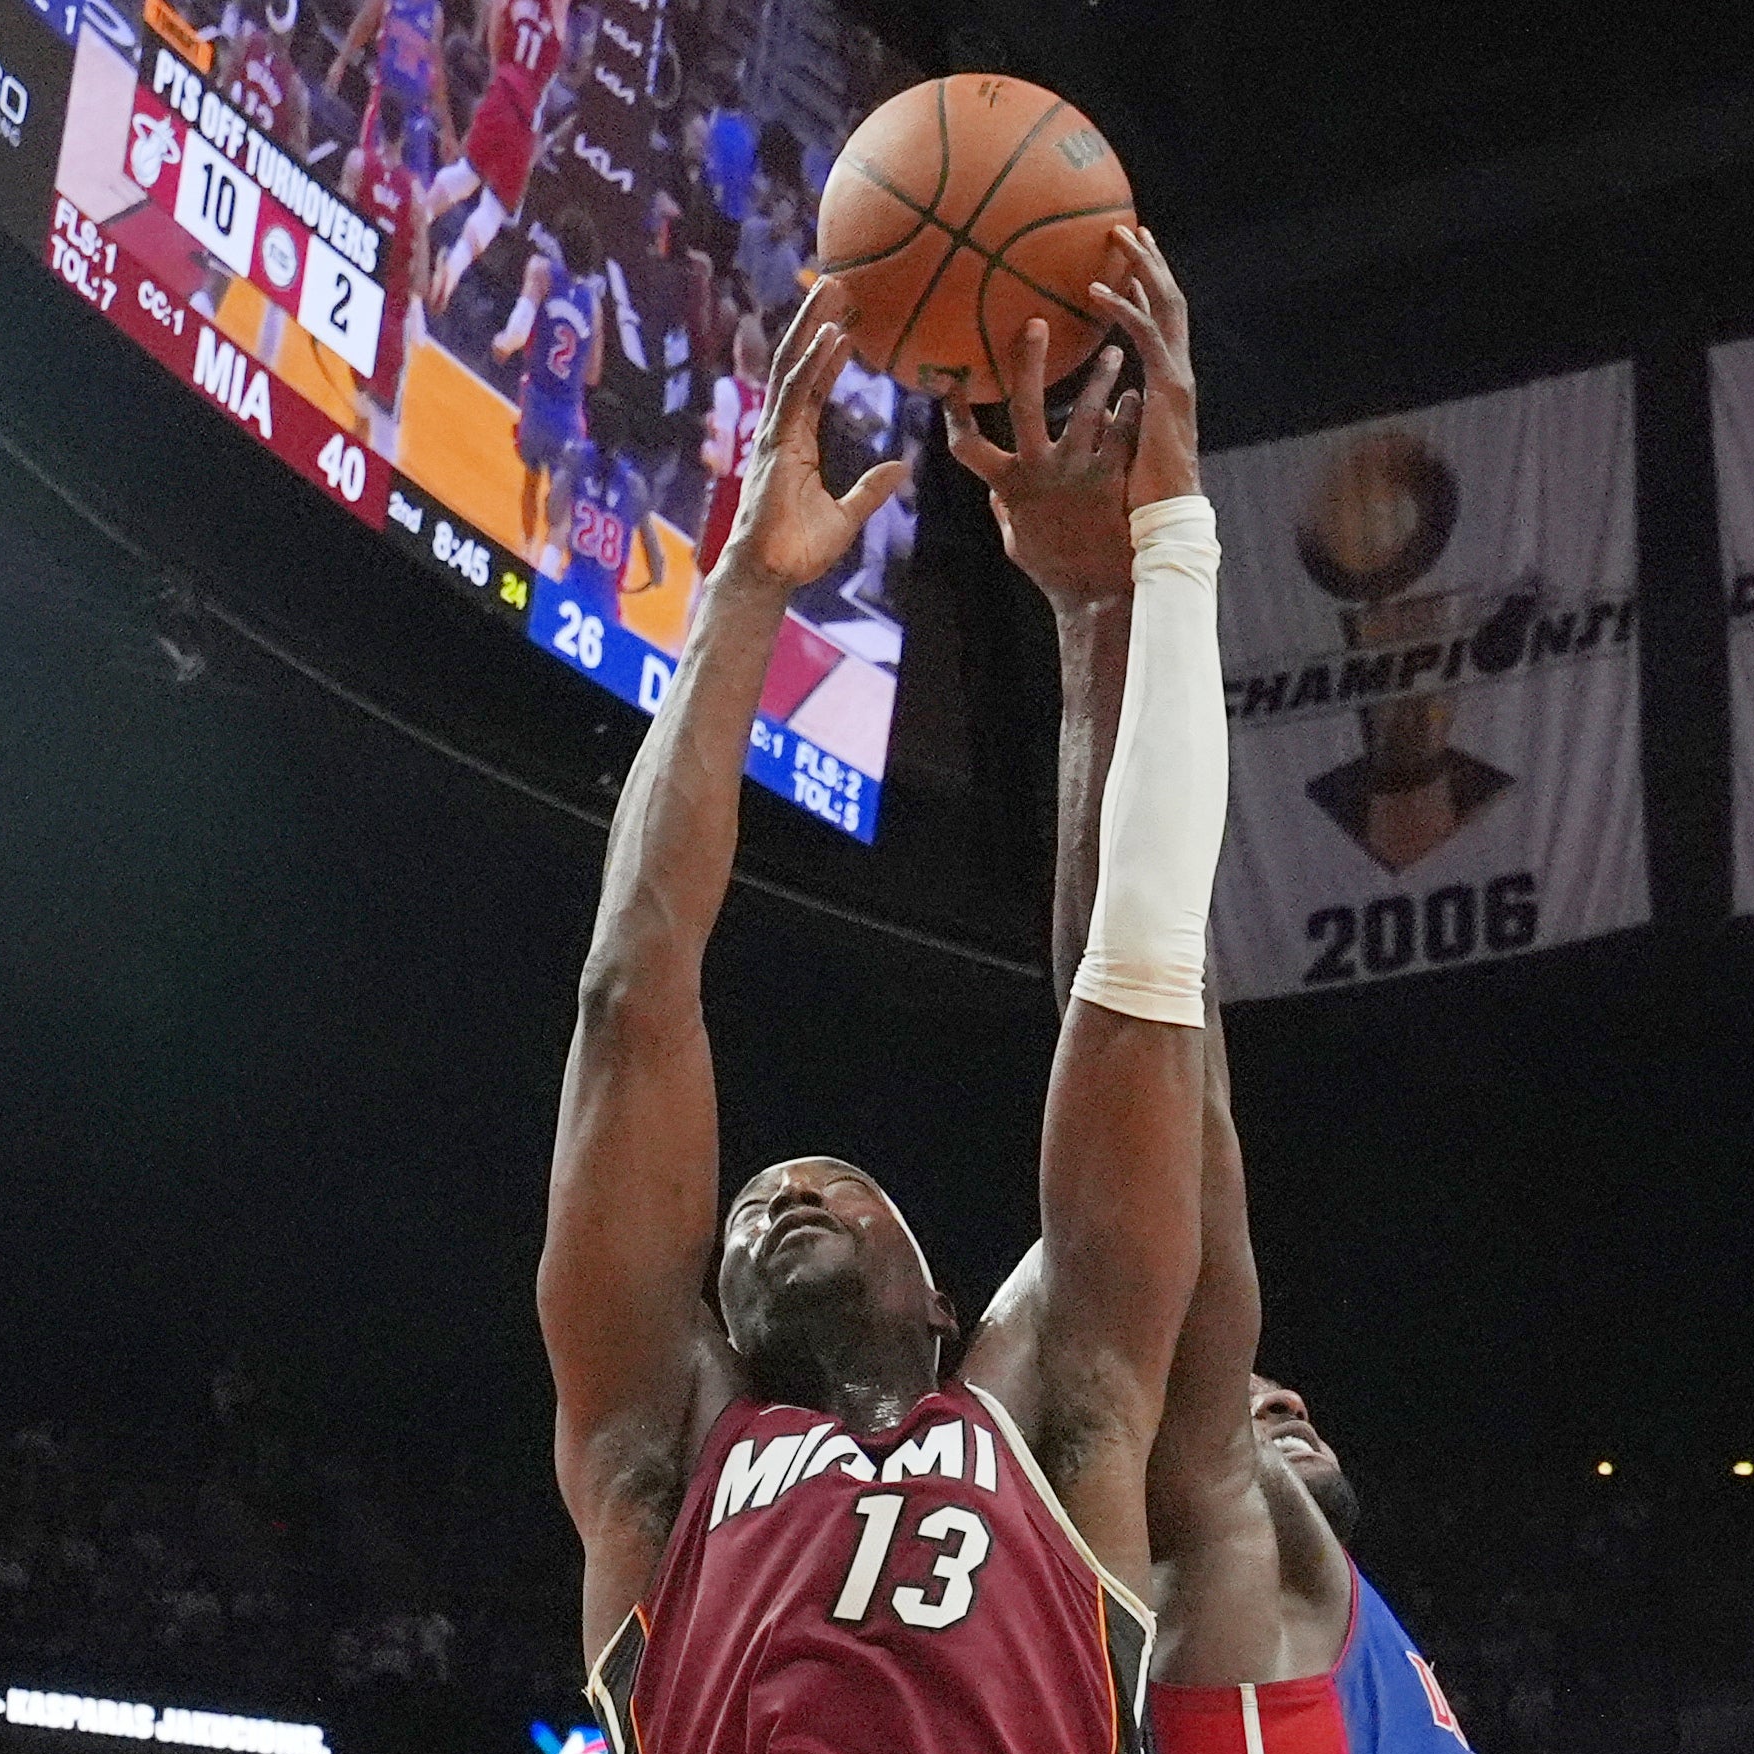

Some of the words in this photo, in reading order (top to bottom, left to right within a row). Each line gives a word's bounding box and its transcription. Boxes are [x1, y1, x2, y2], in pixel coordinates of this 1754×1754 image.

[153, 49, 203, 122] PTS
[199, 92, 246, 159] OFF
[245, 128, 381, 273] TURNOVERS
[203, 162, 236, 236] 10
[330, 272, 352, 333] 2
[192, 325, 272, 440] MIA
[317, 433, 366, 502] 40
[432, 521, 491, 587] 8:45
[499, 572, 528, 610] 24
[553, 600, 604, 669] 26
[572, 501, 624, 570] 28
[1304, 872, 1539, 987] 2006
[830, 1493, 992, 1630] 13
